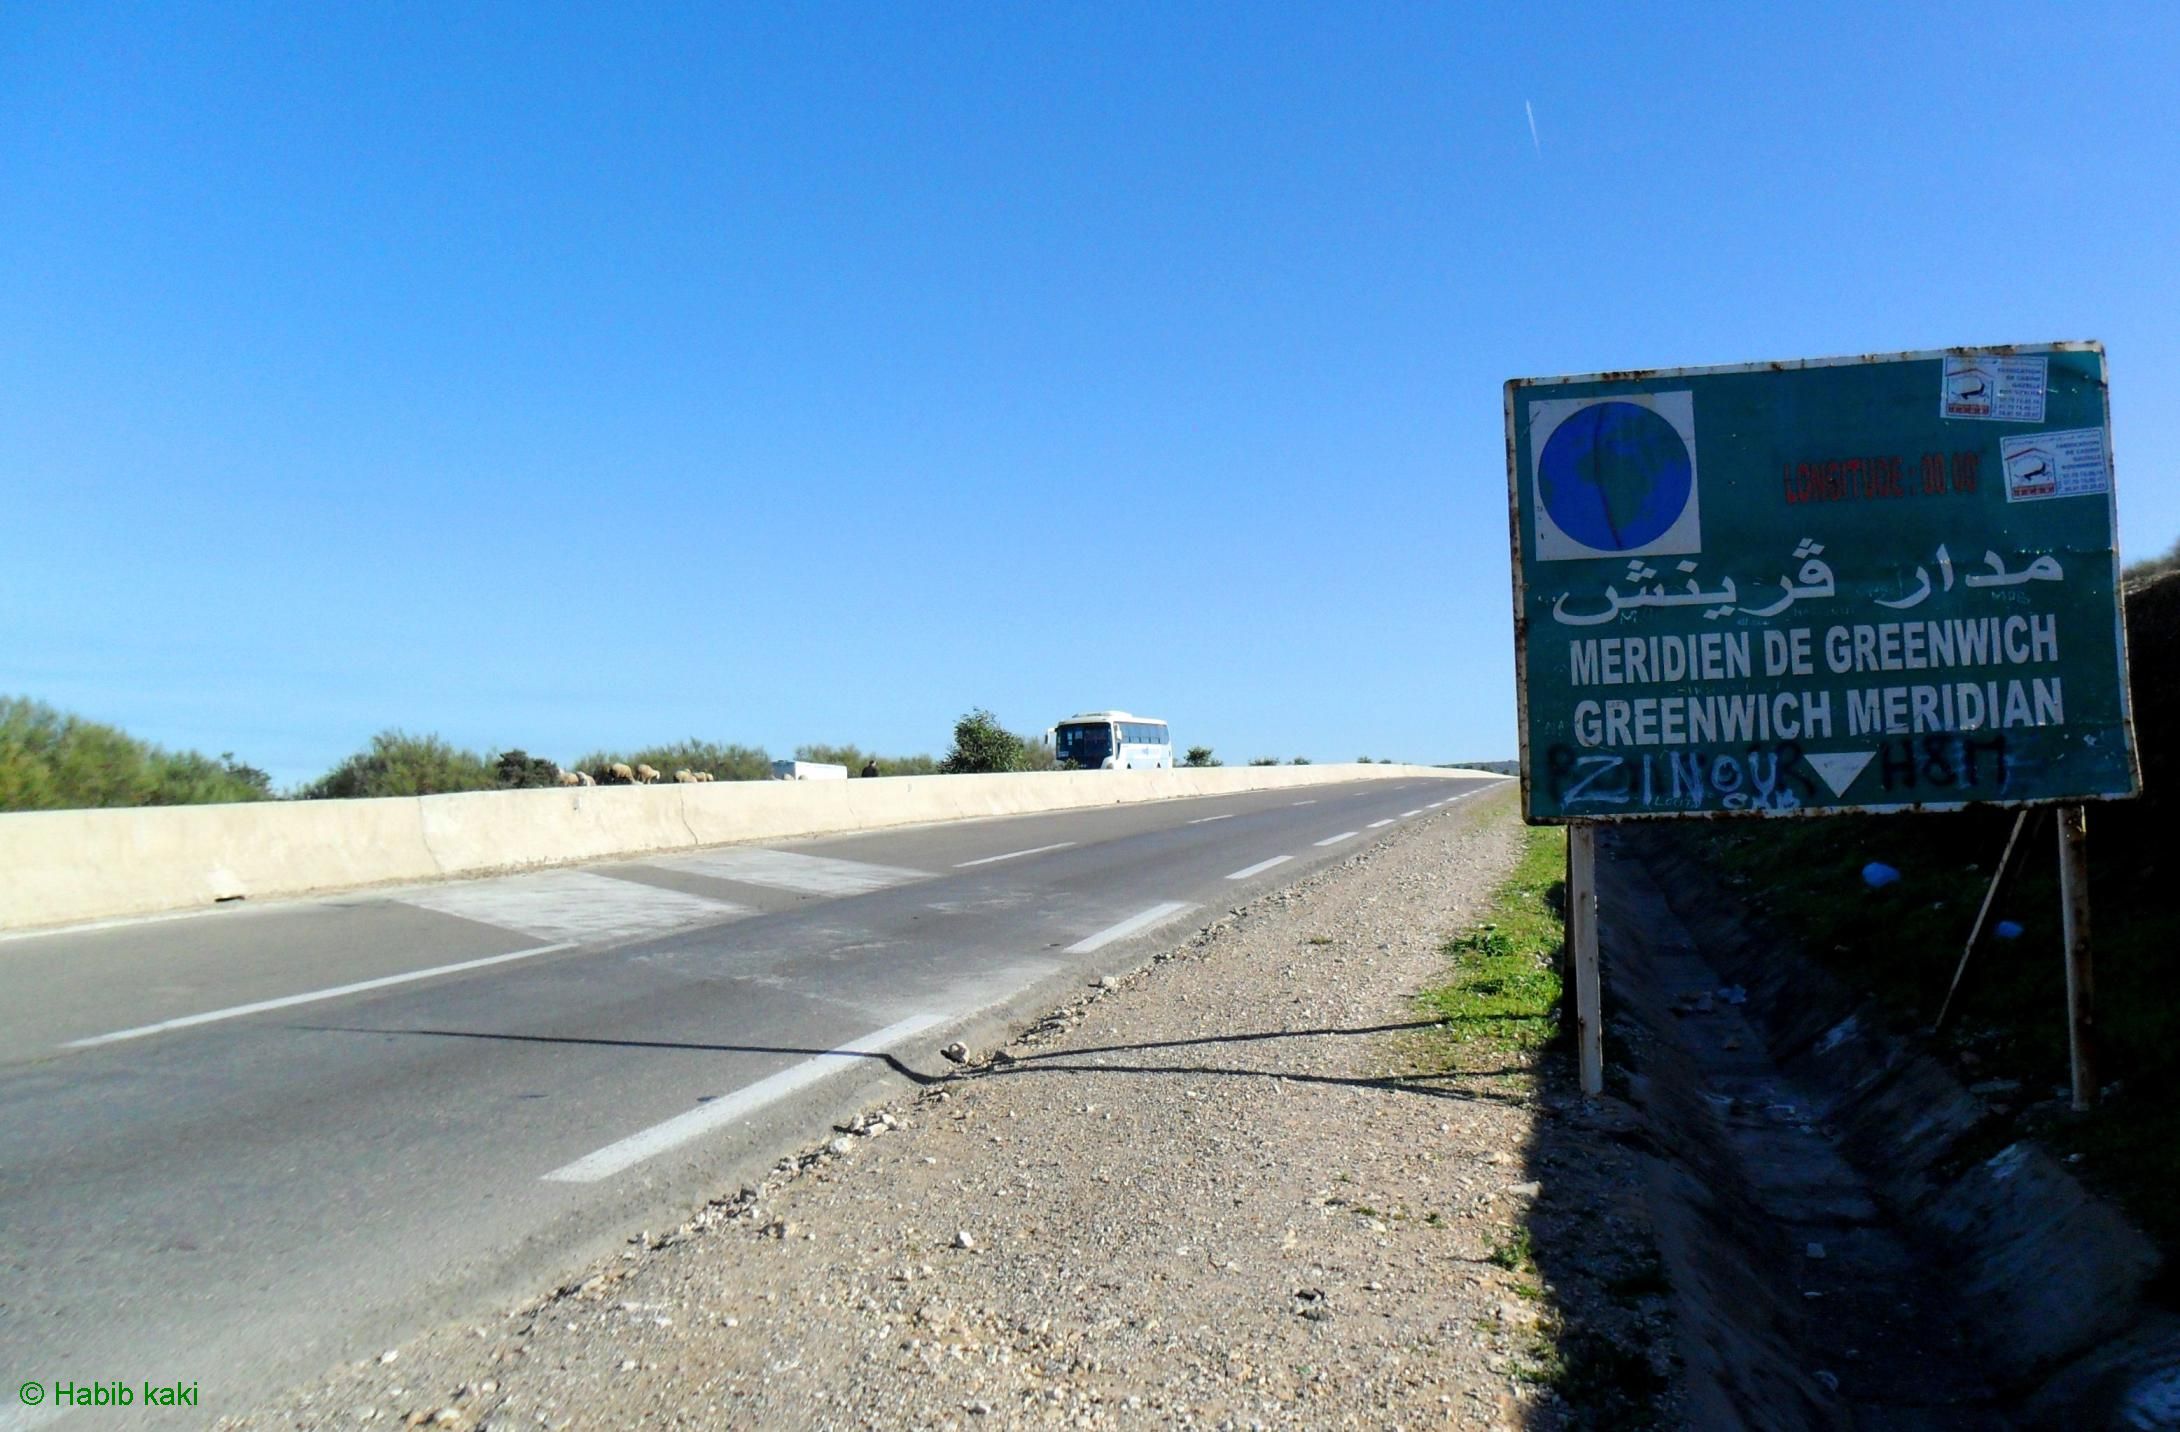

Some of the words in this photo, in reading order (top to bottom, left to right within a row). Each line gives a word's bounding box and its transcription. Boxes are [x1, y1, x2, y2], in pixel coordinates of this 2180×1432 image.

[1874, 544, 2064, 609] مدار
[1570, 632, 1751, 686] MERIDIEN
[1764, 629, 1813, 676] DE
[1826, 615, 2058, 673] GREENWICH
[1574, 692, 1832, 746] GREENWICH
[1848, 678, 2064, 736] MERIDIAN
